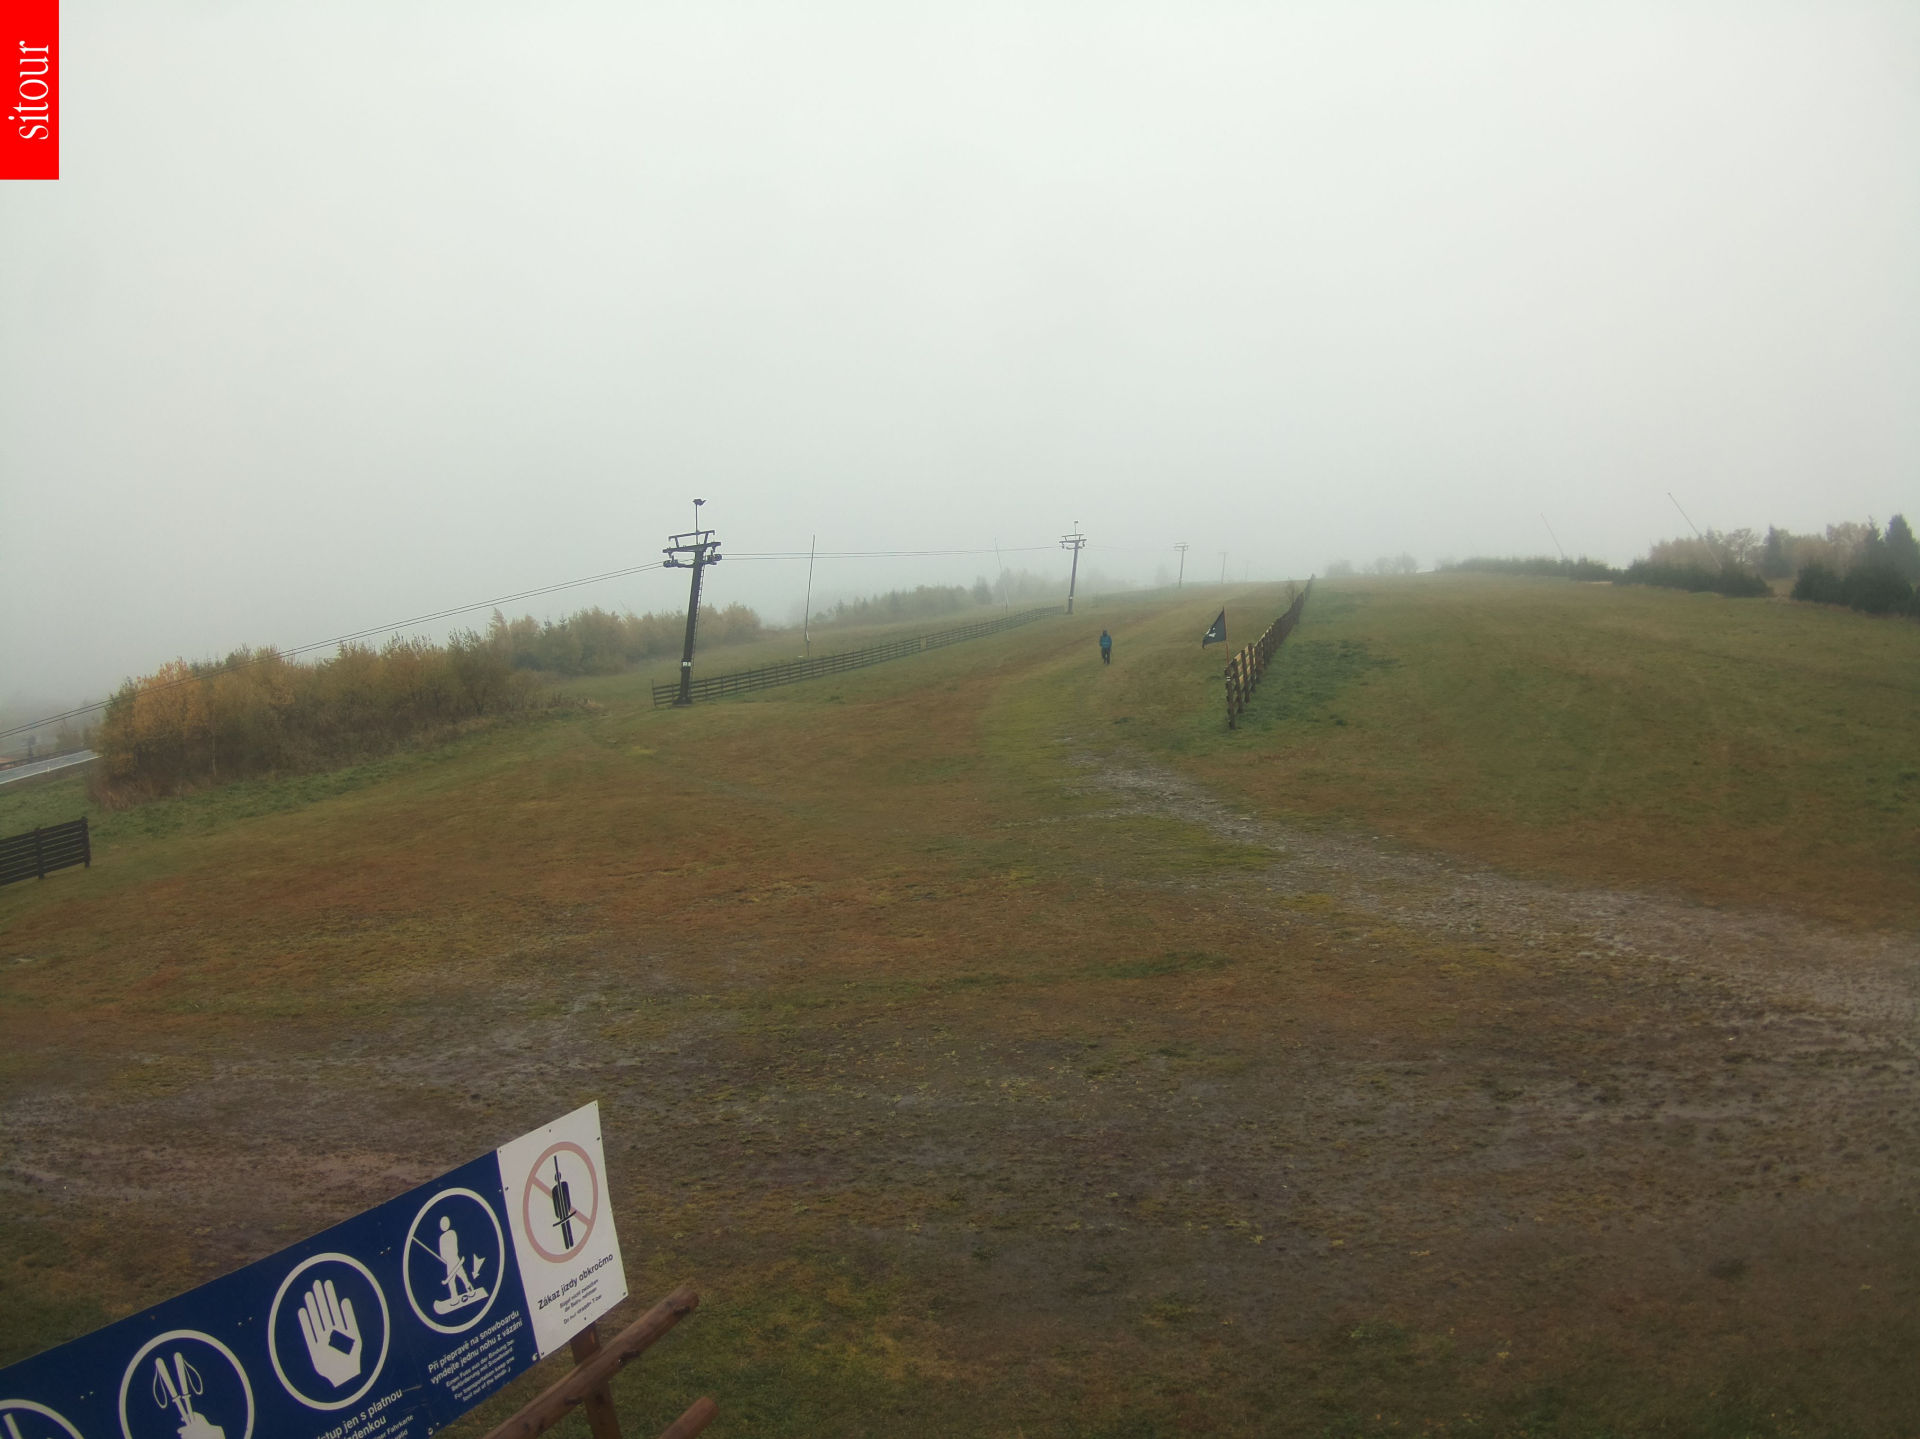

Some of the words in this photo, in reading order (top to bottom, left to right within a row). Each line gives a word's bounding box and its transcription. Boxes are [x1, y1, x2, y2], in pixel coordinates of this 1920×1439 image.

[537, 1290, 560, 1310] Zákaz
[561, 1277, 578, 1296] jízdy
[578, 1254, 613, 1281] obkročmo
[428, 1360, 439, 1373] Při
[439, 1340, 470, 1367] přepravě
[470, 1336, 479, 1346] na
[479, 1310, 520, 1340] snowboardu
[430, 1361, 460, 1384] vyndejte
[460, 1348, 479, 1367] jednu
[479, 1337, 497, 1352] nohu
[497, 1333, 502, 1342] z
[502, 1318, 523, 1338] vázání
[342, 1416, 359, 1434] jen
[360, 1411, 367, 1421] s
[367, 1388, 403, 1418] platnou
